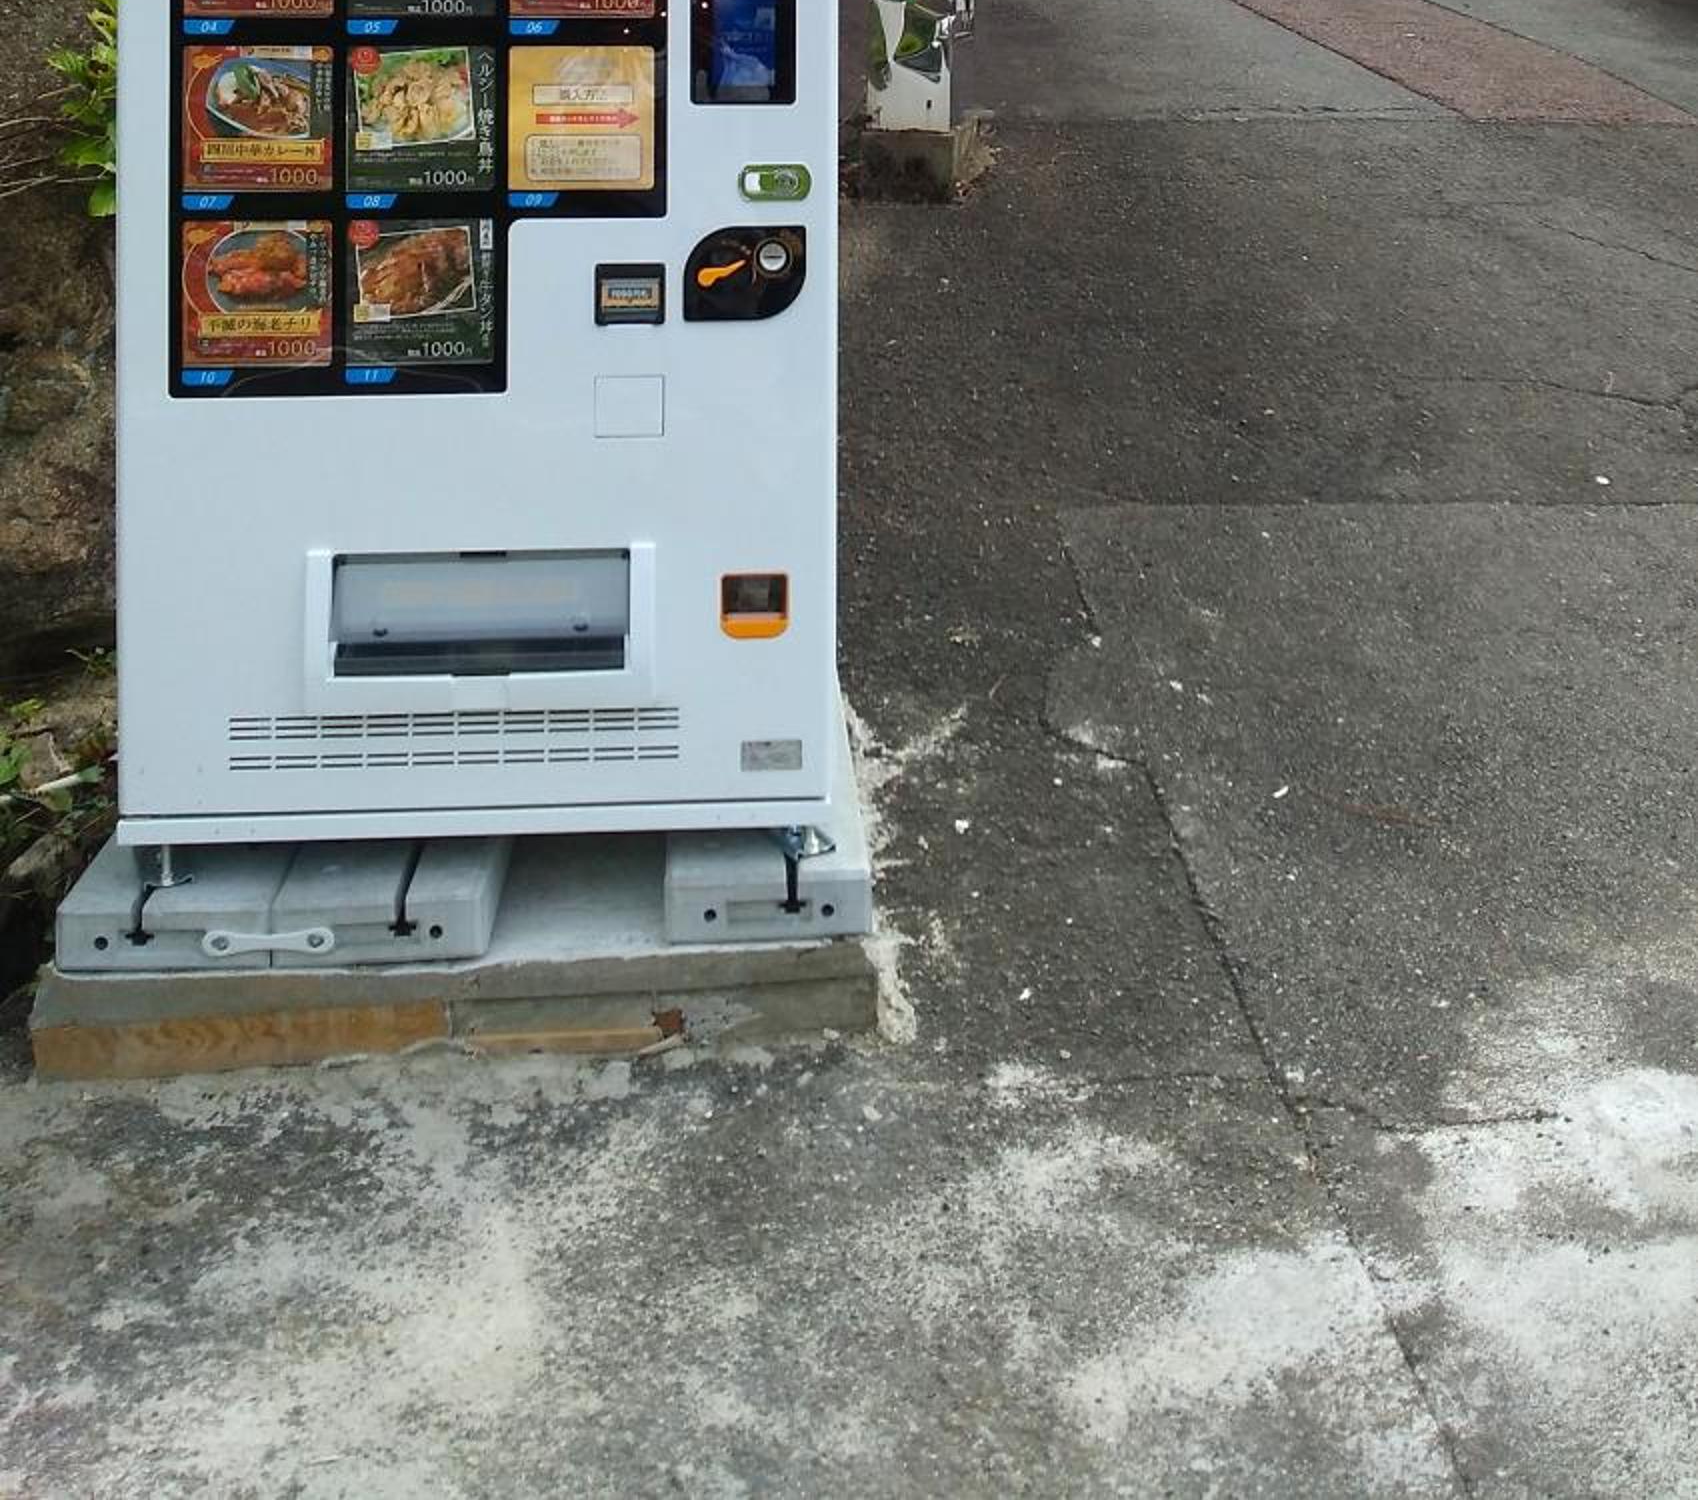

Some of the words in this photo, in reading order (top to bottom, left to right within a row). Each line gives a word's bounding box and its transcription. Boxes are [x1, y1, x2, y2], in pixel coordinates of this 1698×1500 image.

[200, 20, 217, 33] 04
[364, 21, 381, 33] 05
[526, 21, 543, 33] 06
[476, 51, 495, 174] ヘルシー焼き鳥丼
[199, 195, 216, 208] 07
[363, 195, 380, 208] 08
[525, 194, 543, 206] 09
[200, 371, 216, 384] 10
[365, 369, 379, 381] 11
